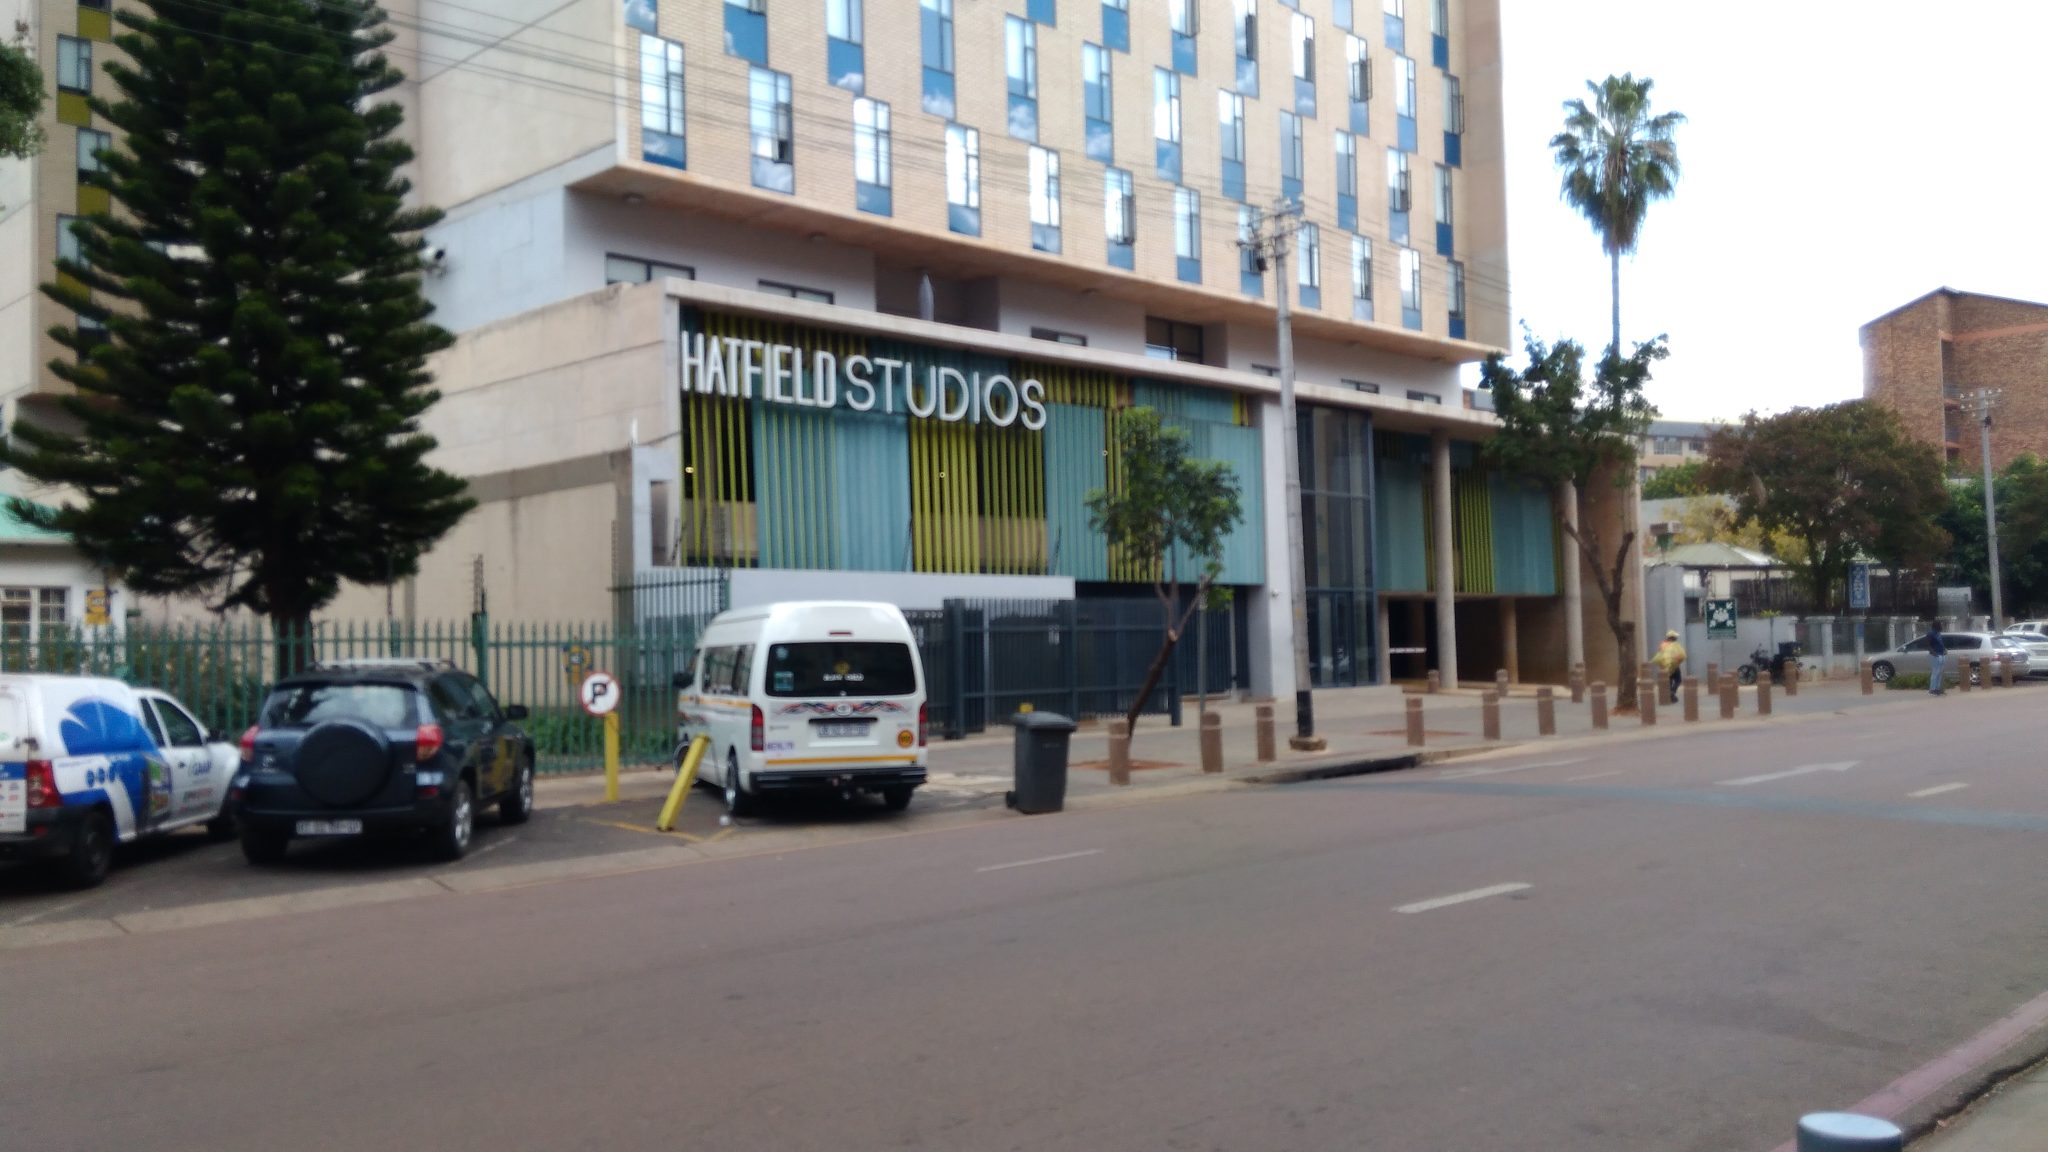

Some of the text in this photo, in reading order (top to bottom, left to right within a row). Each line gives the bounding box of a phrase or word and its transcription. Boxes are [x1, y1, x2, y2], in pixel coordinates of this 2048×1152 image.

[681, 330, 1047, 431] HATFIELD STUDIOS
[592, 682, 607, 704] P
